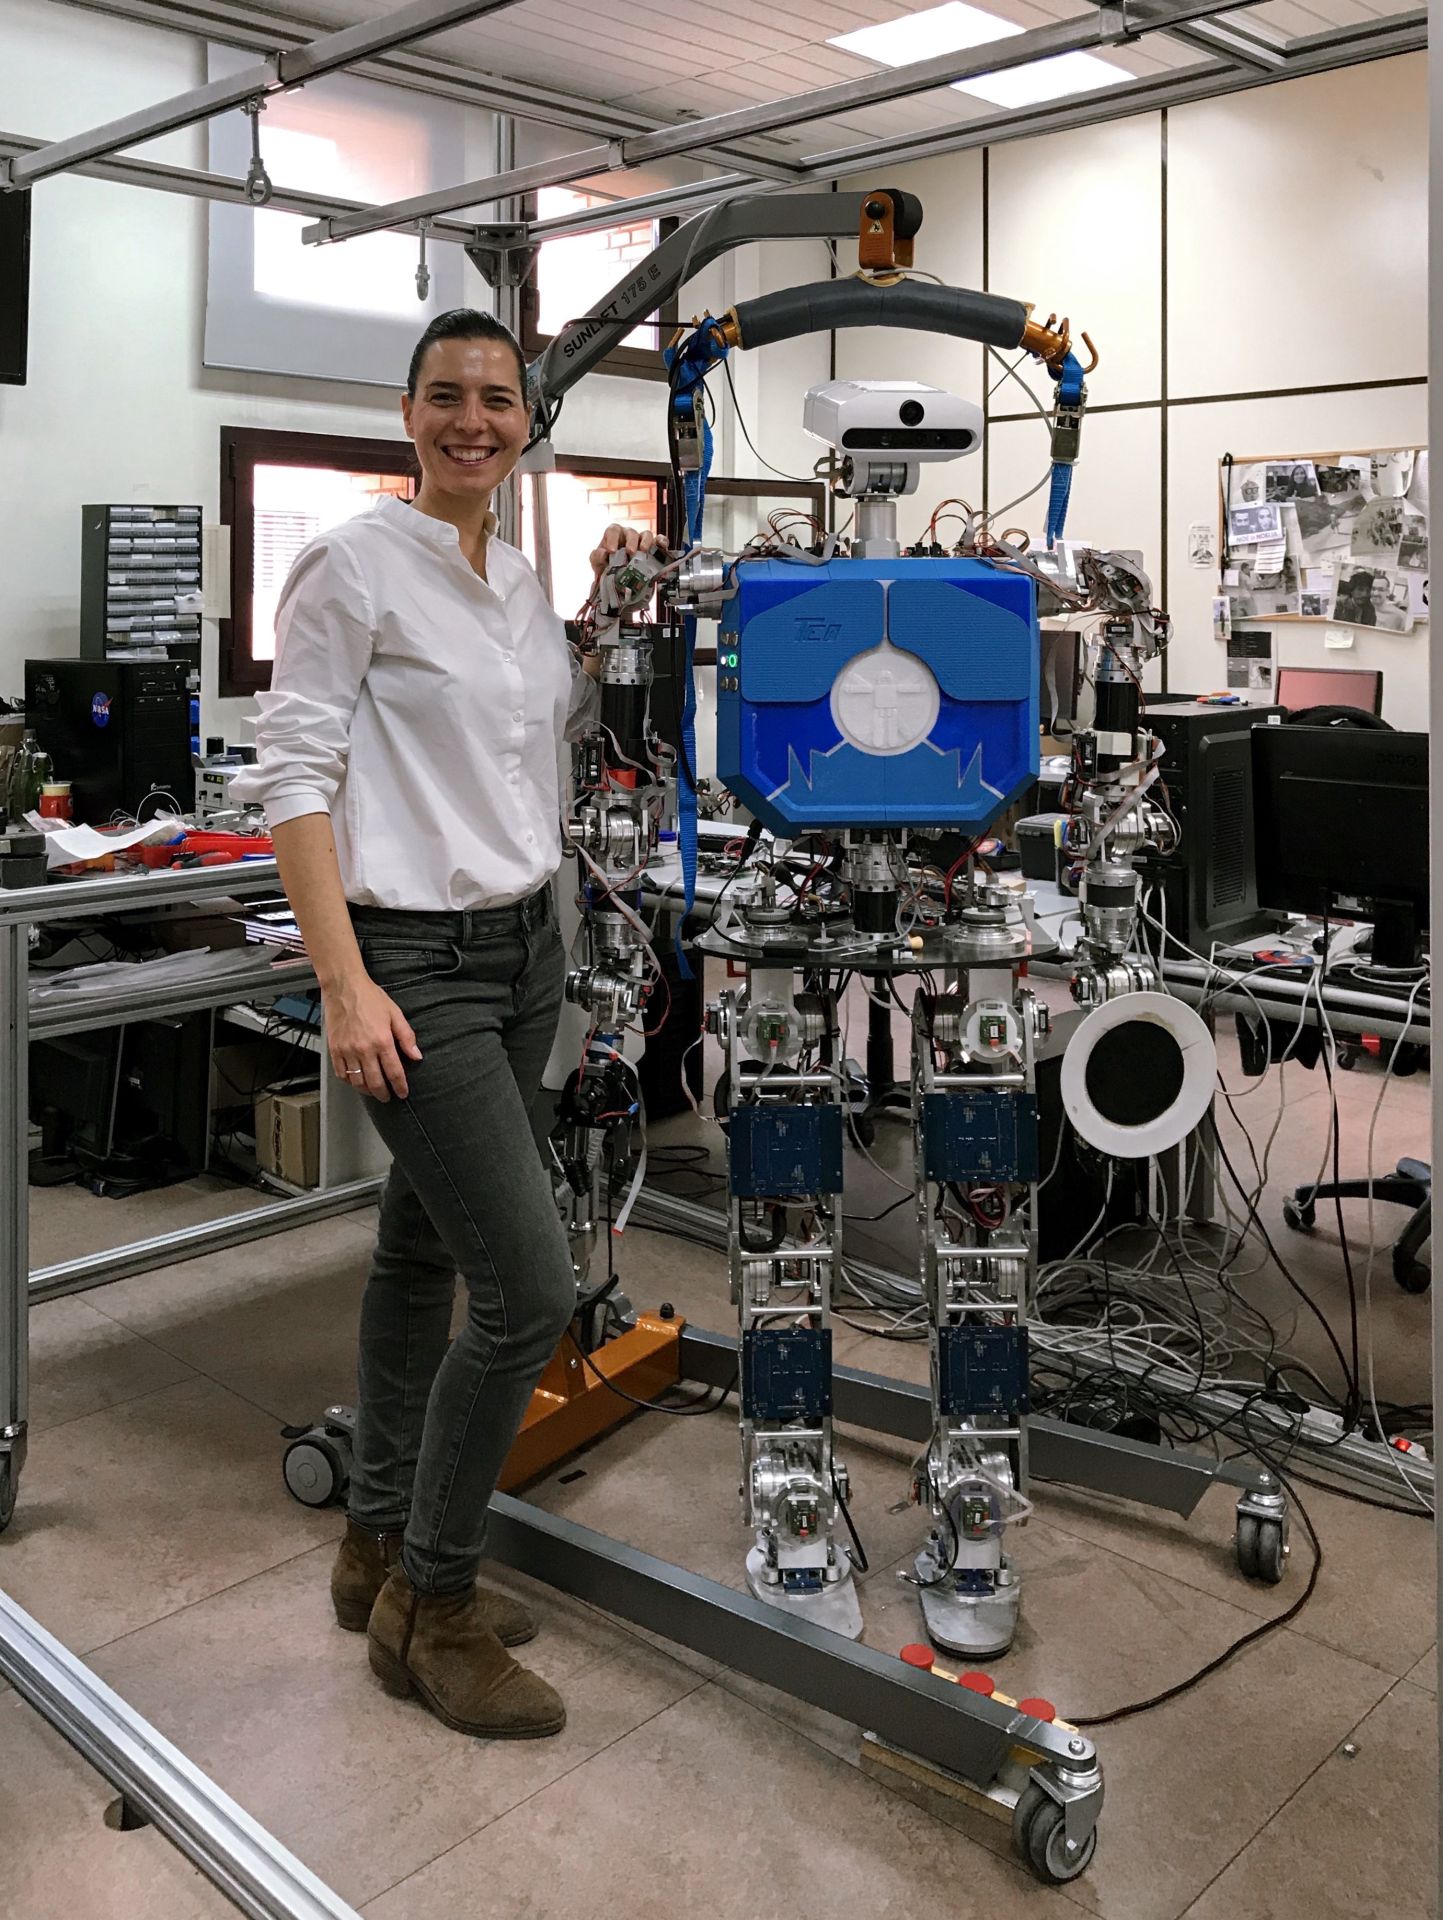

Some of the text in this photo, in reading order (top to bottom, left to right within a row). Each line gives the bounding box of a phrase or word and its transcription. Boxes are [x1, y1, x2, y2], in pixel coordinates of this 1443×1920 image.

[621, 276, 647, 304] 175
[648, 263, 661, 280] E
[93, 704, 109, 715] NASA
